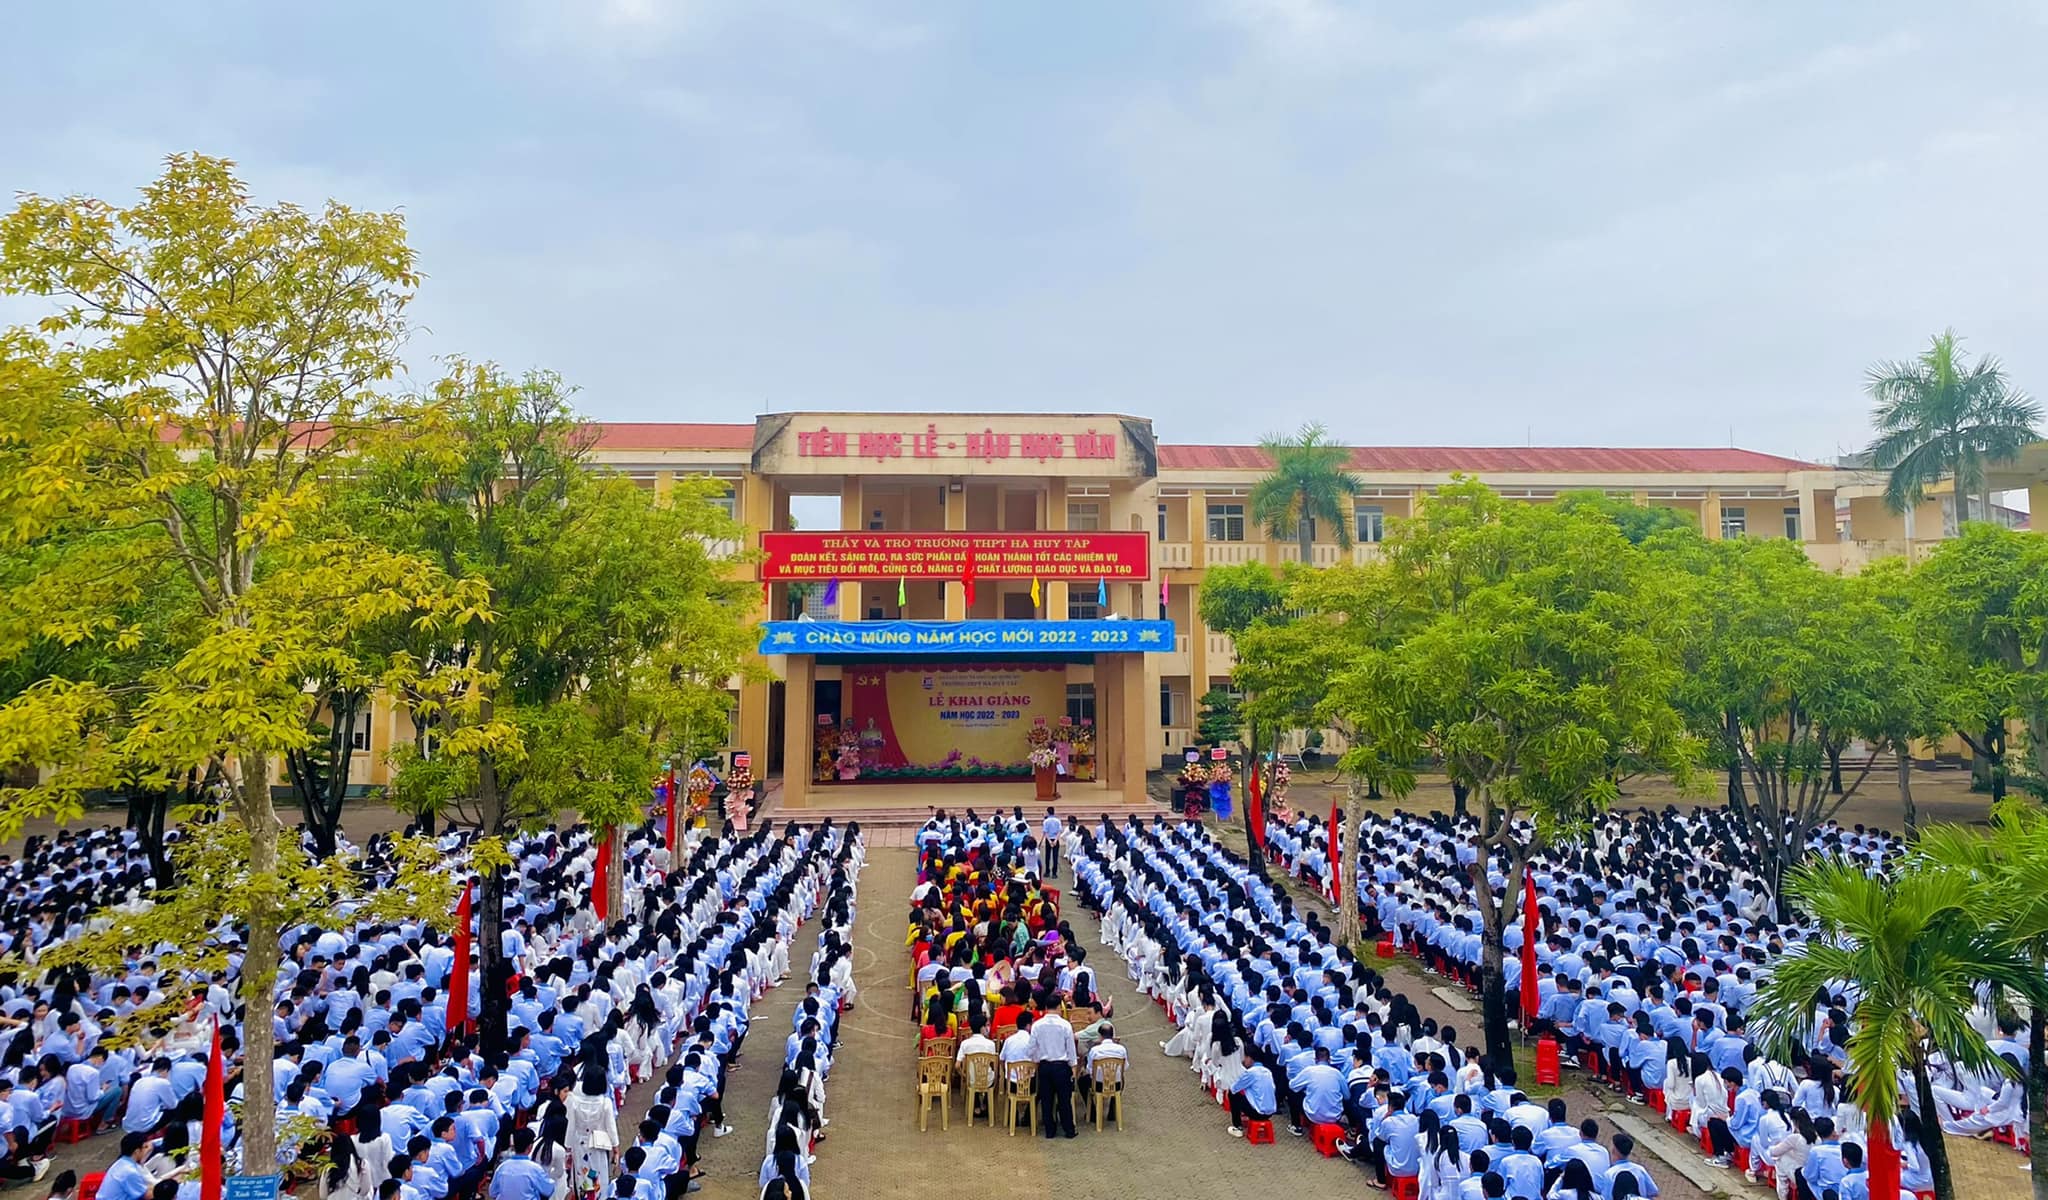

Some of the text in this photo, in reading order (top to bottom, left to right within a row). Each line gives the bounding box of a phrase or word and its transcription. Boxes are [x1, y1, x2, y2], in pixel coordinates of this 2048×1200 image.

[858, 432, 902, 463] HỌC
[914, 424, 938, 458] LỄ
[966, 428, 1010, 463] HẬU
[1021, 433, 1064, 464] HỌC
[1074, 428, 1115, 459] VĂN
[864, 537, 880, 548] VÀ
[973, 539, 1007, 548] THPT
[1033, 539, 1061, 548] HUY
[890, 553, 902, 561] RA
[916, 629, 954, 644] NĂM
[959, 630, 997, 647] HỌC
[1002, 627, 1034, 643] MỚI
[1039, 630, 1077, 643] 2022
[1091, 630, 1128, 643] 2023
[929, 692, 1032, 707] LỄ KHAI GIẢNG
[940, 709, 958, 719] NĂM
[960, 710, 975, 721] HỌC
[976, 711, 995, 719] 2022
[1001, 710, 1020, 719] 2023
